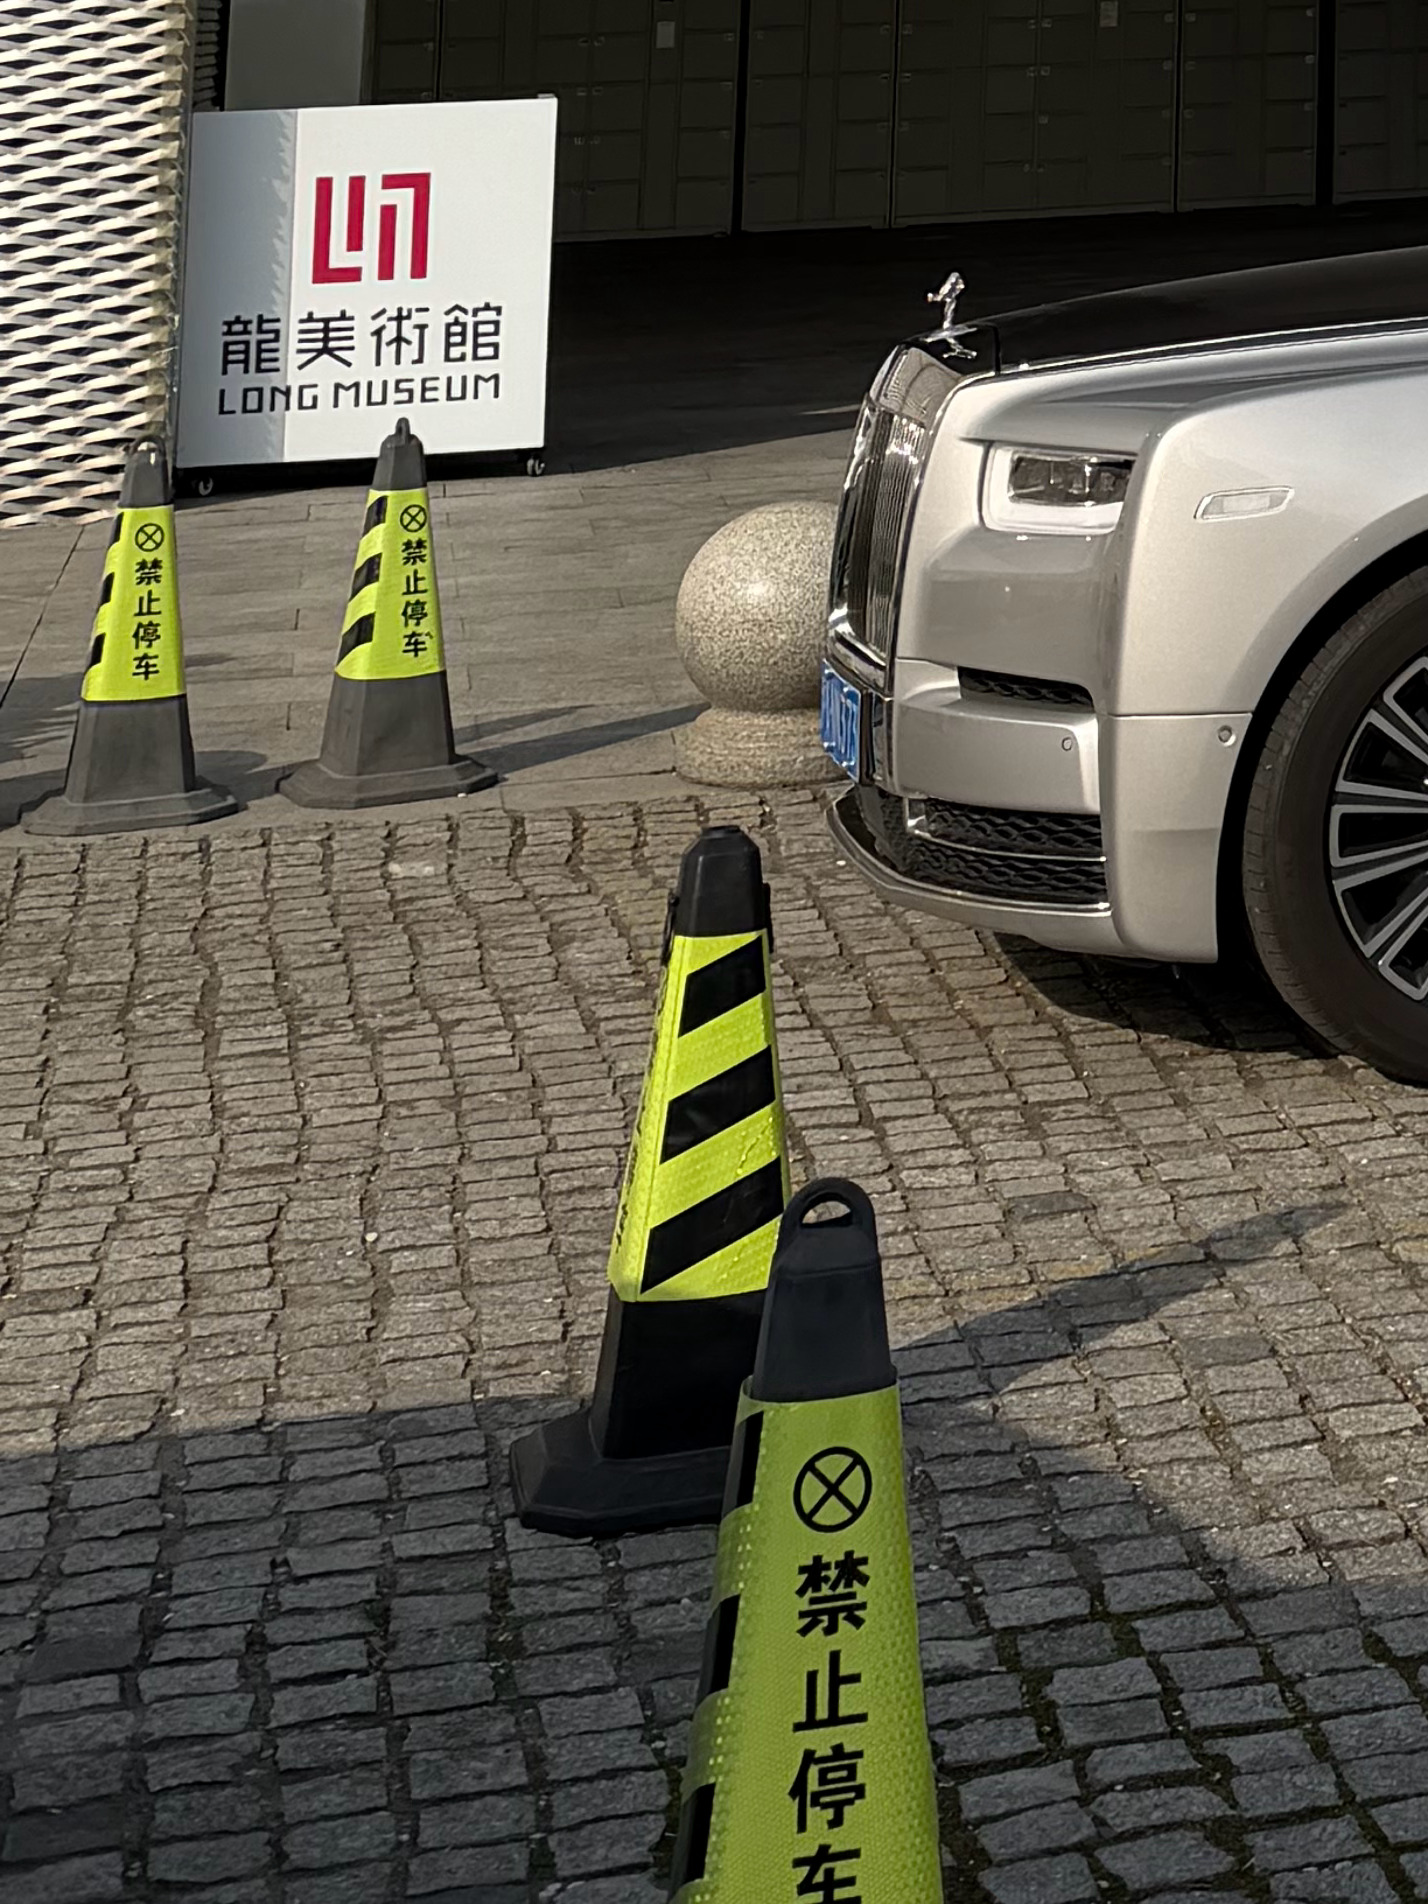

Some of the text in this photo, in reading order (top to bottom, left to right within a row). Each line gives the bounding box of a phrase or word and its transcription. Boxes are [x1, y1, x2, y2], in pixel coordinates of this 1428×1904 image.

[218, 373, 500, 415] LONG MUSEUM
[221, 302, 502, 375] 龍美術館
[132, 558, 163, 681] 禁止停车
[401, 538, 429, 657] 禁止停车
[788, 1550, 870, 1904] 禁止停车
